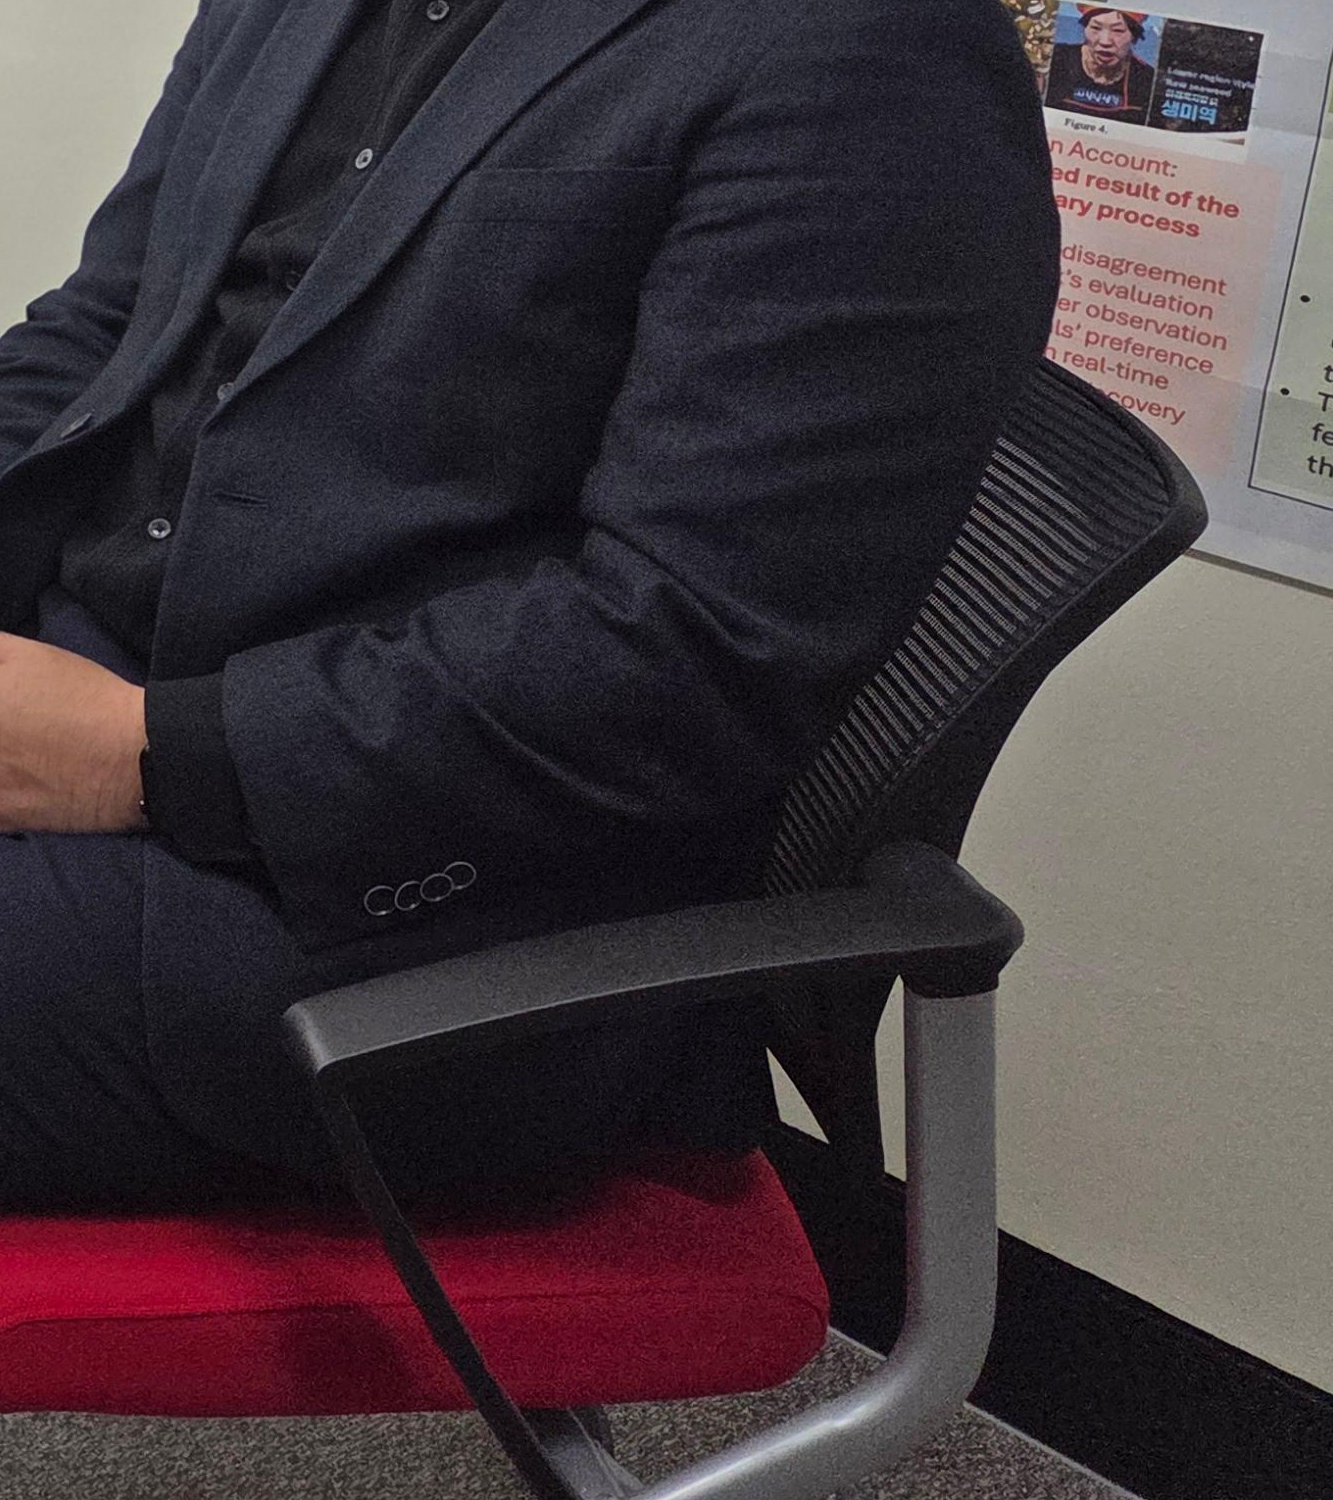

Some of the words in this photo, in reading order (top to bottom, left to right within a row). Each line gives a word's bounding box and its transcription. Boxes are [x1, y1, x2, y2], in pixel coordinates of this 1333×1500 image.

[1064, 117, 1096, 133] Figure
[1161, 99, 1218, 126] 생미역
[1068, 139, 1179, 179] Account:
[1085, 171, 1161, 203] result
[1165, 190, 1195, 210] of
[1196, 195, 1241, 218] the
[1096, 203, 1201, 239] process
[1061, 244, 1228, 297] disagreement
[1088, 279, 1215, 321] evaluation
[1085, 302, 1229, 351] observation
[1062, 348, 1170, 391] real-time
[1083, 328, 1215, 375] preference
